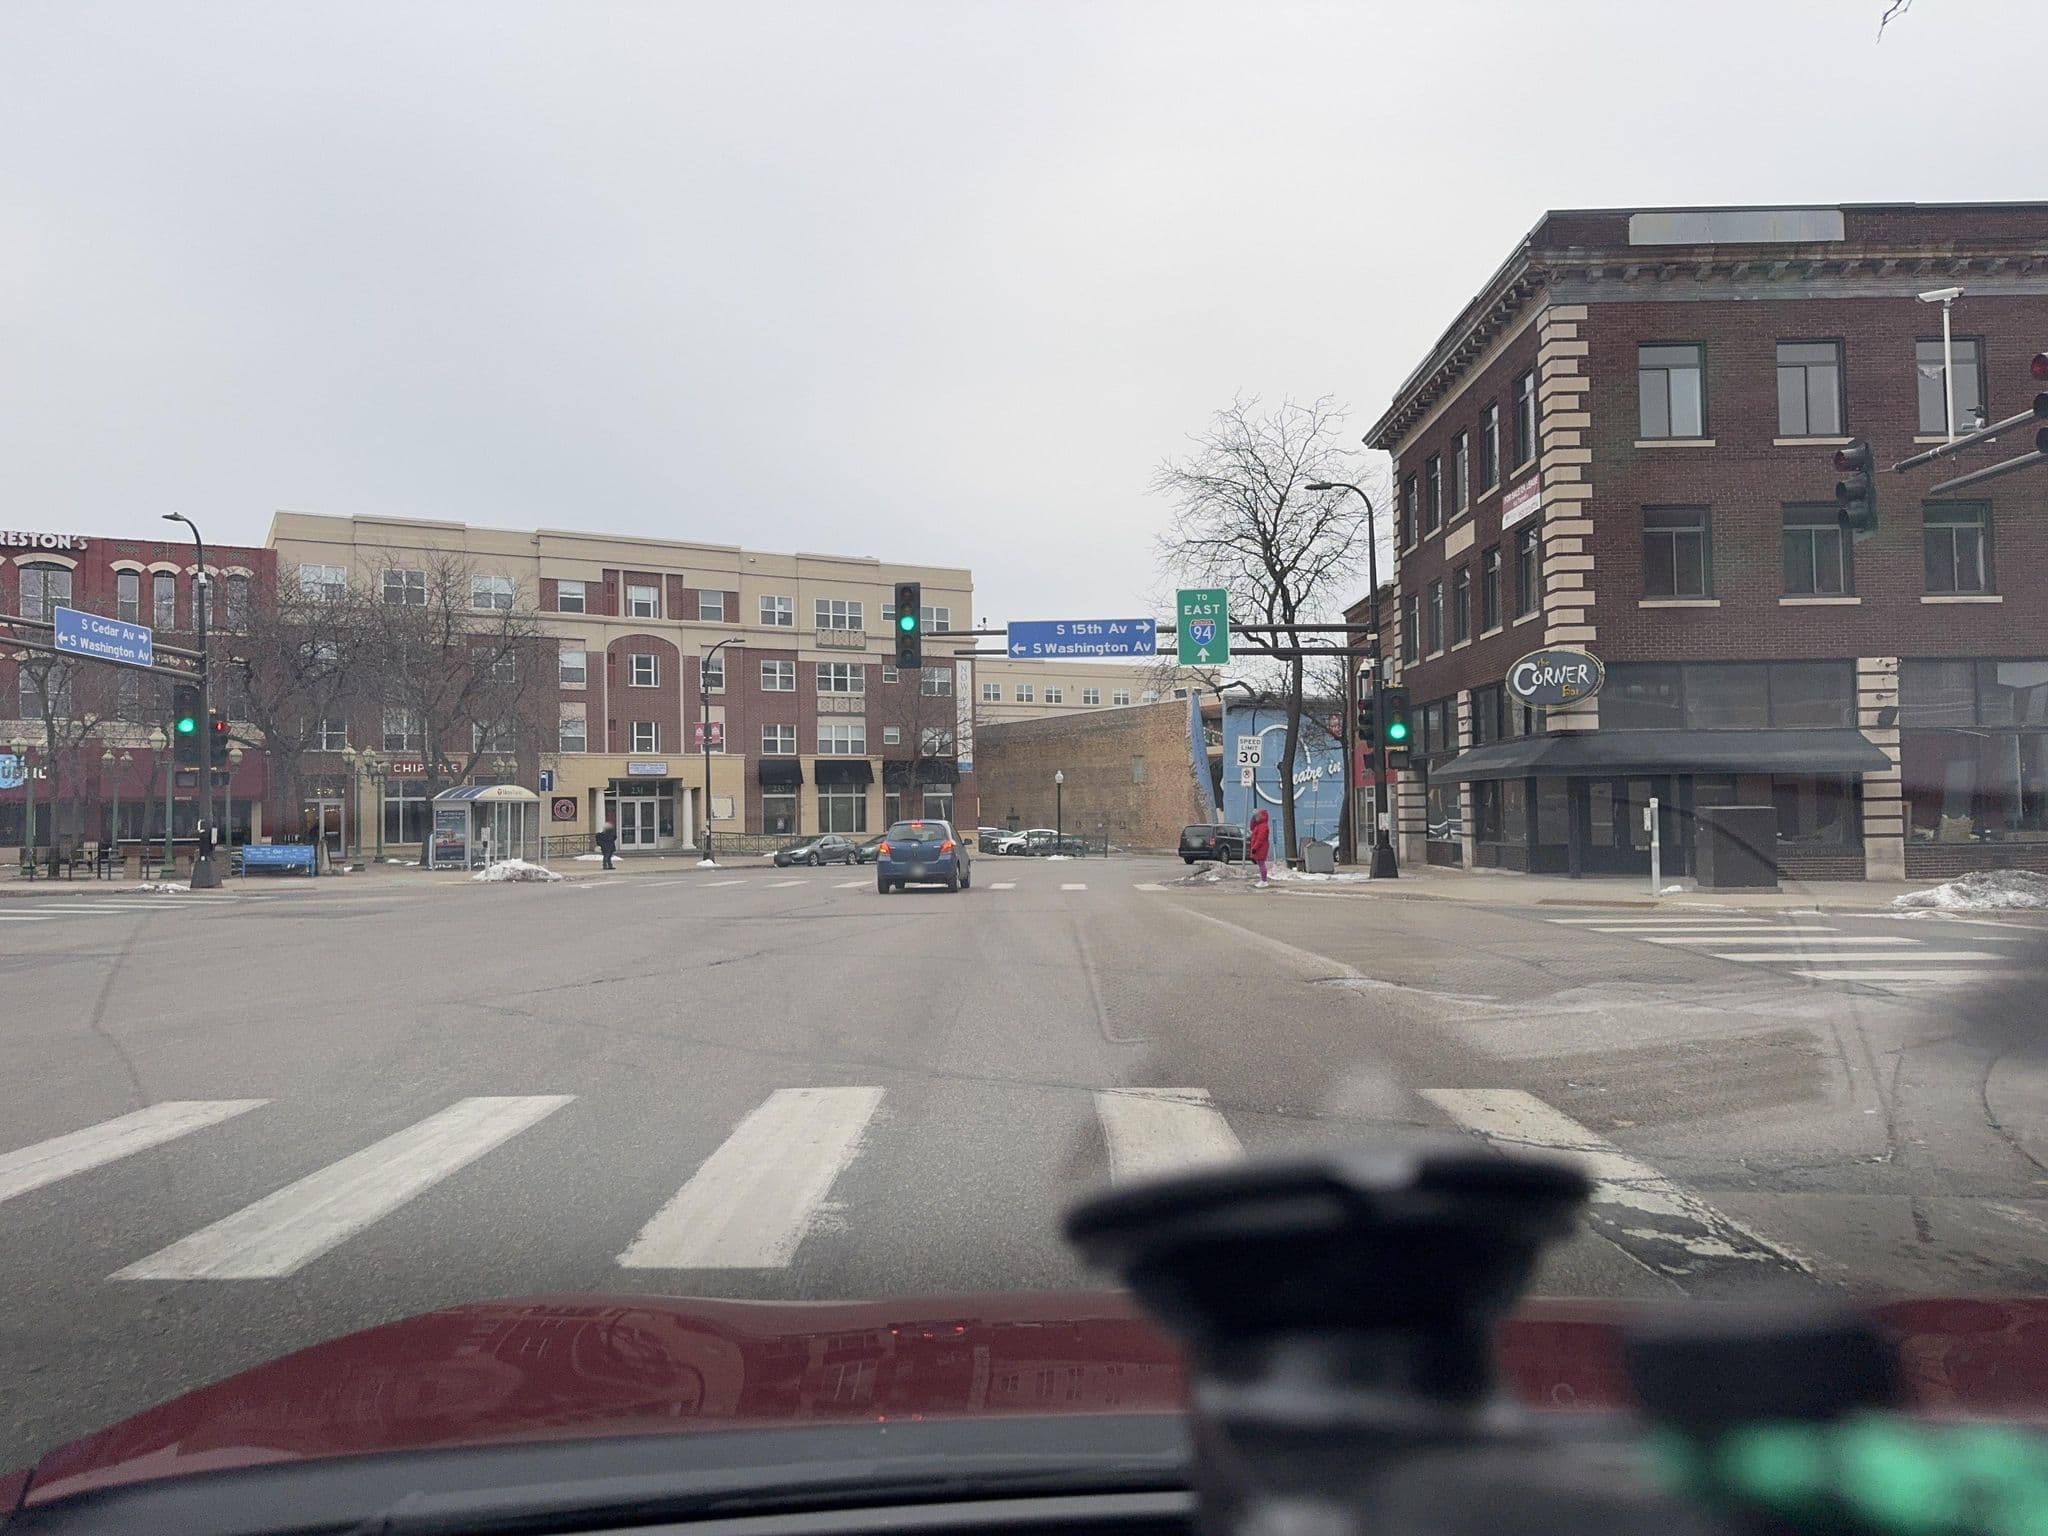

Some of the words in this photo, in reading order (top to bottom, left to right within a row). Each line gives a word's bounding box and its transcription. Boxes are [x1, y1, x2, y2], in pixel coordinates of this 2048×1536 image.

[1184, 604, 1220, 615] EAST
[81, 618, 88, 630] S
[91, 621, 119, 637] Cedar
[122, 628, 135, 640] Av
[1056, 624, 1065, 635] S
[1072, 623, 1102, 635] 15th
[1108, 623, 1128, 634] Av
[1193, 625, 1212, 640] 94
[70, 635, 77, 647] S
[80, 637, 135, 658] Washington
[138, 649, 150, 661] Av
[1033, 643, 1042, 654] S
[1045, 642, 1128, 655] Washington
[1133, 641, 1151, 652] Av
[1536, 657, 1550, 667] the
[1239, 751, 1260, 764] 30
[393, 763, 460, 773] CHIPTLE
